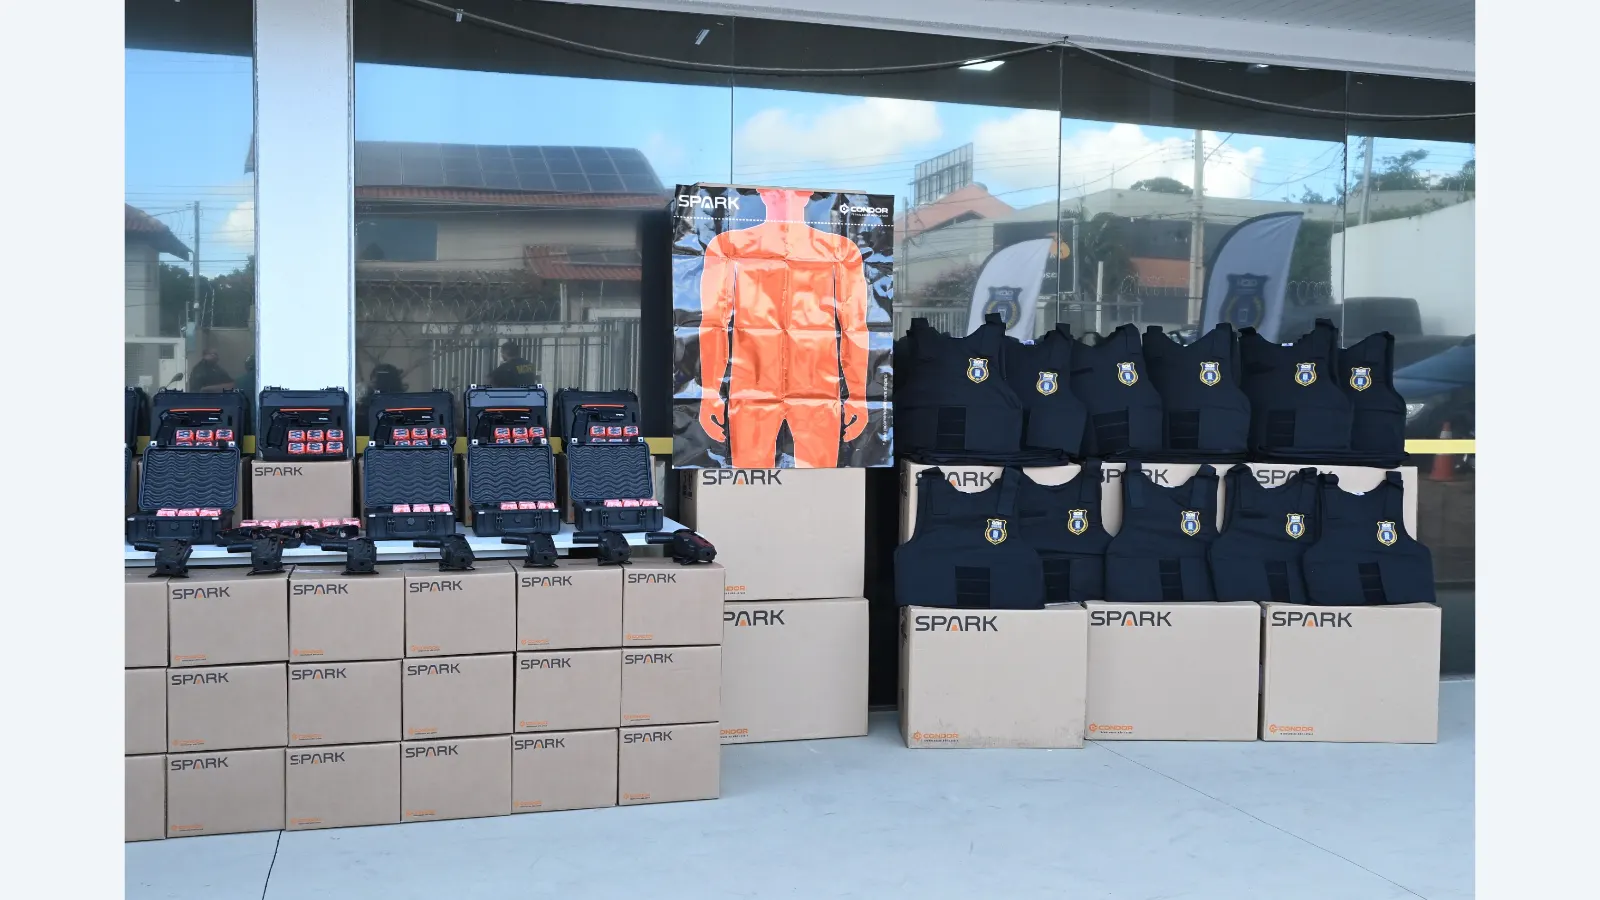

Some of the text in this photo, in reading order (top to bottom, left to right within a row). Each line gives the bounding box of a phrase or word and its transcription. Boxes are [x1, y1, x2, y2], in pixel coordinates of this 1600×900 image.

[678, 194, 740, 210] SPARK
[851, 206, 889, 214] CONDOR
[254, 466, 303, 476] SPARK
[702, 469, 783, 485] SPARK
[522, 575, 572, 587] SPARK
[628, 573, 676, 583] SPARK
[293, 583, 348, 595] SPARK
[410, 580, 462, 592] SPARK
[172, 586, 230, 599] SPARK
[724, 610, 785, 626] PARK
[916, 616, 998, 631] SPARK
[1091, 611, 1171, 626] SPARK
[1272, 612, 1352, 627] SPARK
[521, 658, 571, 669] SPARK
[625, 654, 673, 664] SPARK
[292, 668, 346, 680] SPARK
[408, 664, 460, 675] SPARK
[172, 673, 229, 685] SPARK
[624, 731, 672, 743] SPARK
[515, 739, 565, 750] SPARK
[406, 746, 458, 758] SPARK
[171, 757, 229, 771] SPARK
[290, 752, 345, 765] SPARK
